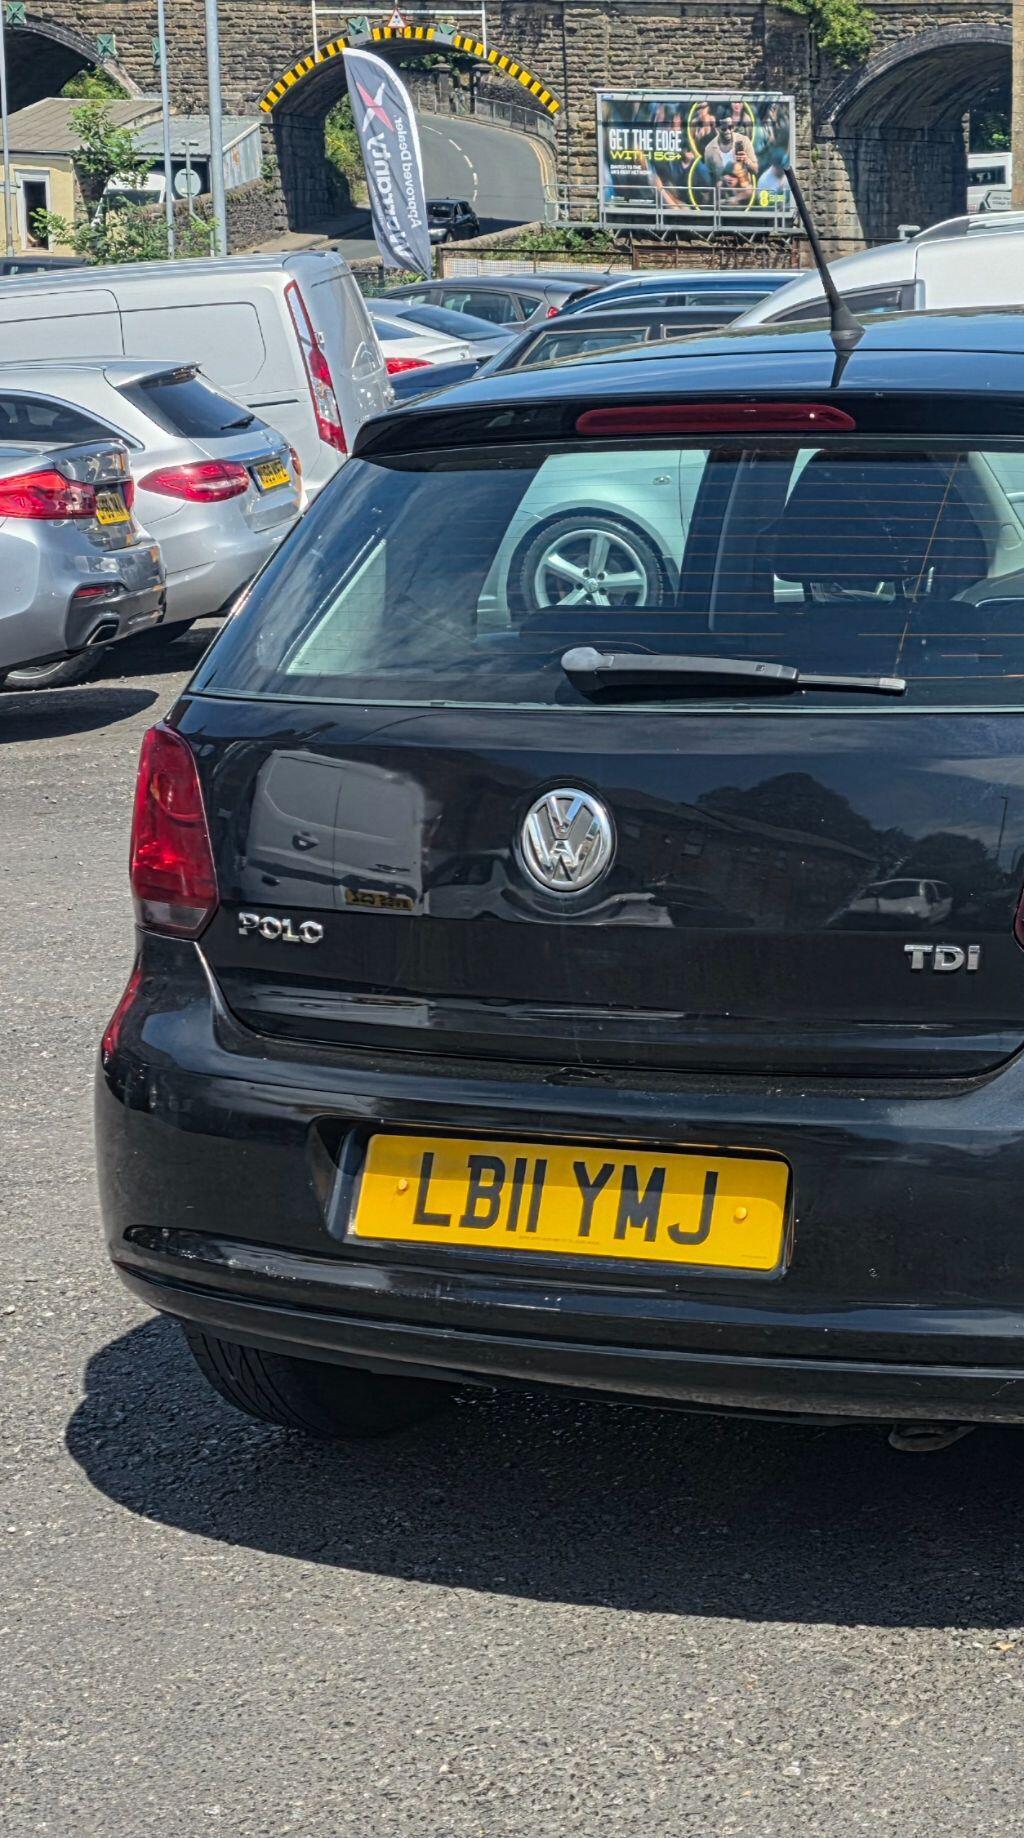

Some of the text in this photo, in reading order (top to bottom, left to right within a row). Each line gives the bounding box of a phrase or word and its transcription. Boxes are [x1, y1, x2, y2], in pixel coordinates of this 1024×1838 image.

[609, 129, 682, 152] GET THE EDGE
[610, 150, 652, 160] WITH
[238, 911, 324, 944] POLO
[413, 1151, 720, 1246] LB11 YMJ
